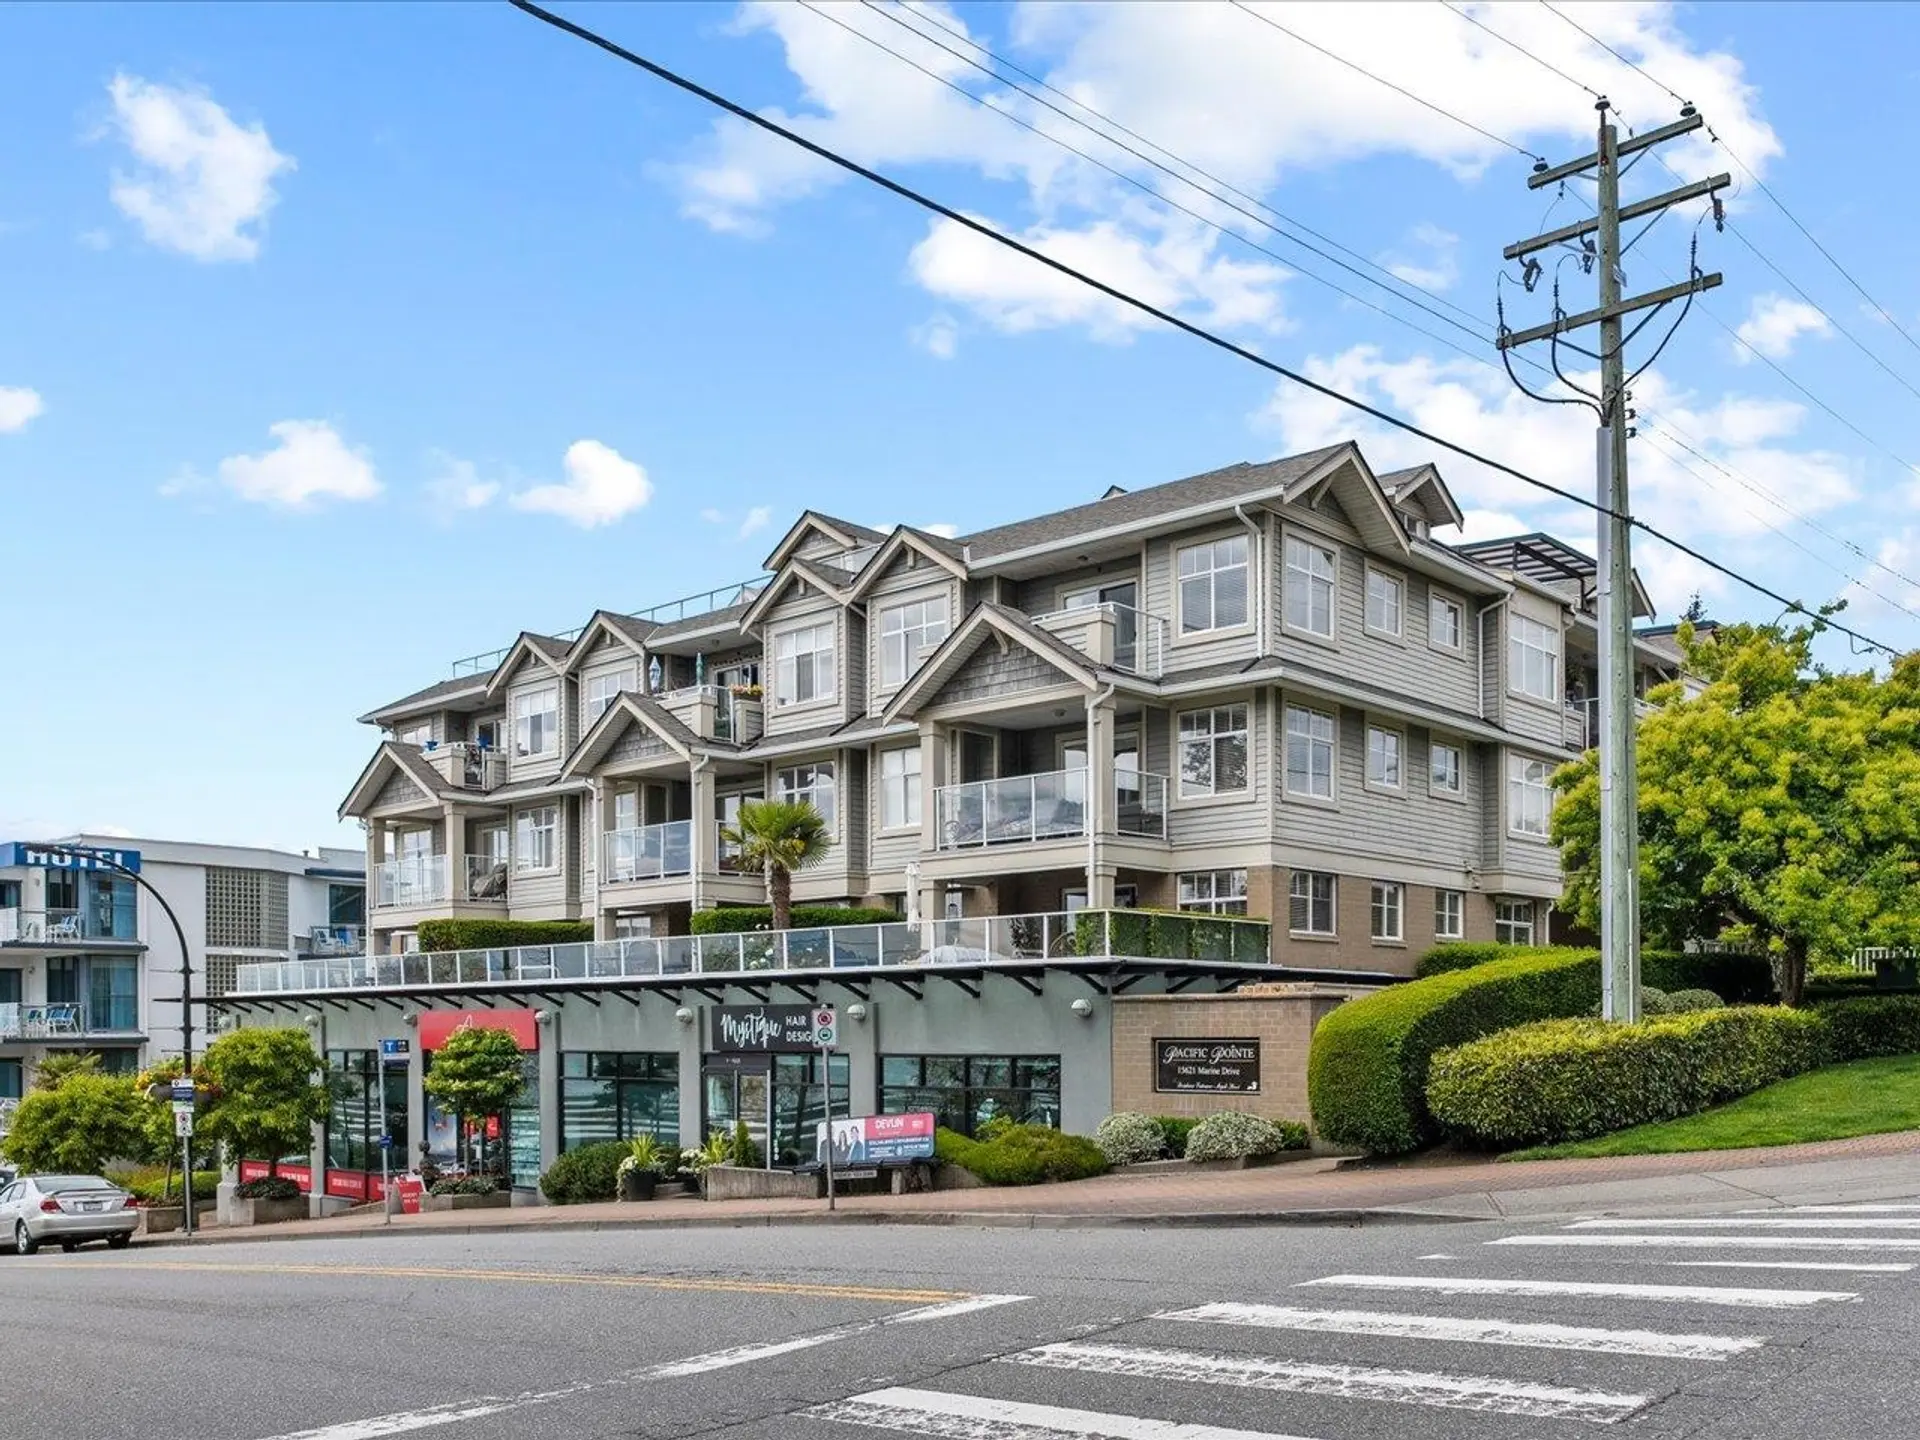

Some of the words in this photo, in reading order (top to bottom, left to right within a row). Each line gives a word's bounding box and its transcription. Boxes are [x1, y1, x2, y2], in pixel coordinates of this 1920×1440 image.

[785, 1015, 807, 1026] HAIR
[720, 1007, 782, 1048] Mystique
[785, 1031, 812, 1042] DESIG
[1198, 1066, 1220, 1076] Marine
[1221, 1066, 1240, 1076] Drive
[875, 1118, 904, 1130] DEVLIN
